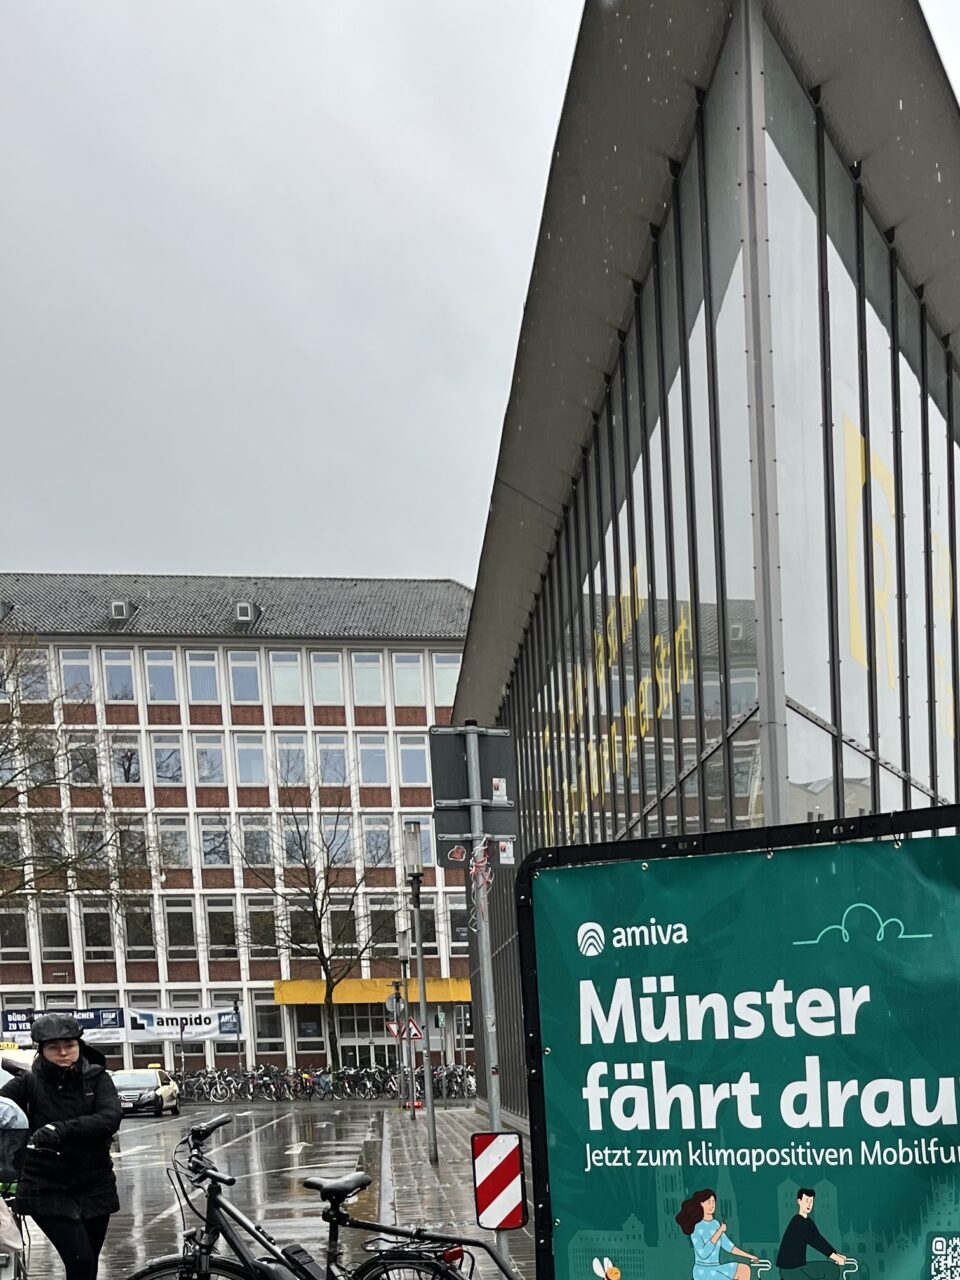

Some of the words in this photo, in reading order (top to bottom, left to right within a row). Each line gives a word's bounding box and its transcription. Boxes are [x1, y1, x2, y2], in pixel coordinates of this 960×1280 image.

[612, 917, 689, 948] amiva
[156, 1014, 212, 1026] ampido
[579, 975, 871, 1045] Münster
[582, 1060, 763, 1131] fährt
[584, 1143, 632, 1172] Jetzt
[637, 1147, 683, 1166] zum
[688, 1140, 853, 1172] klimapositiven
